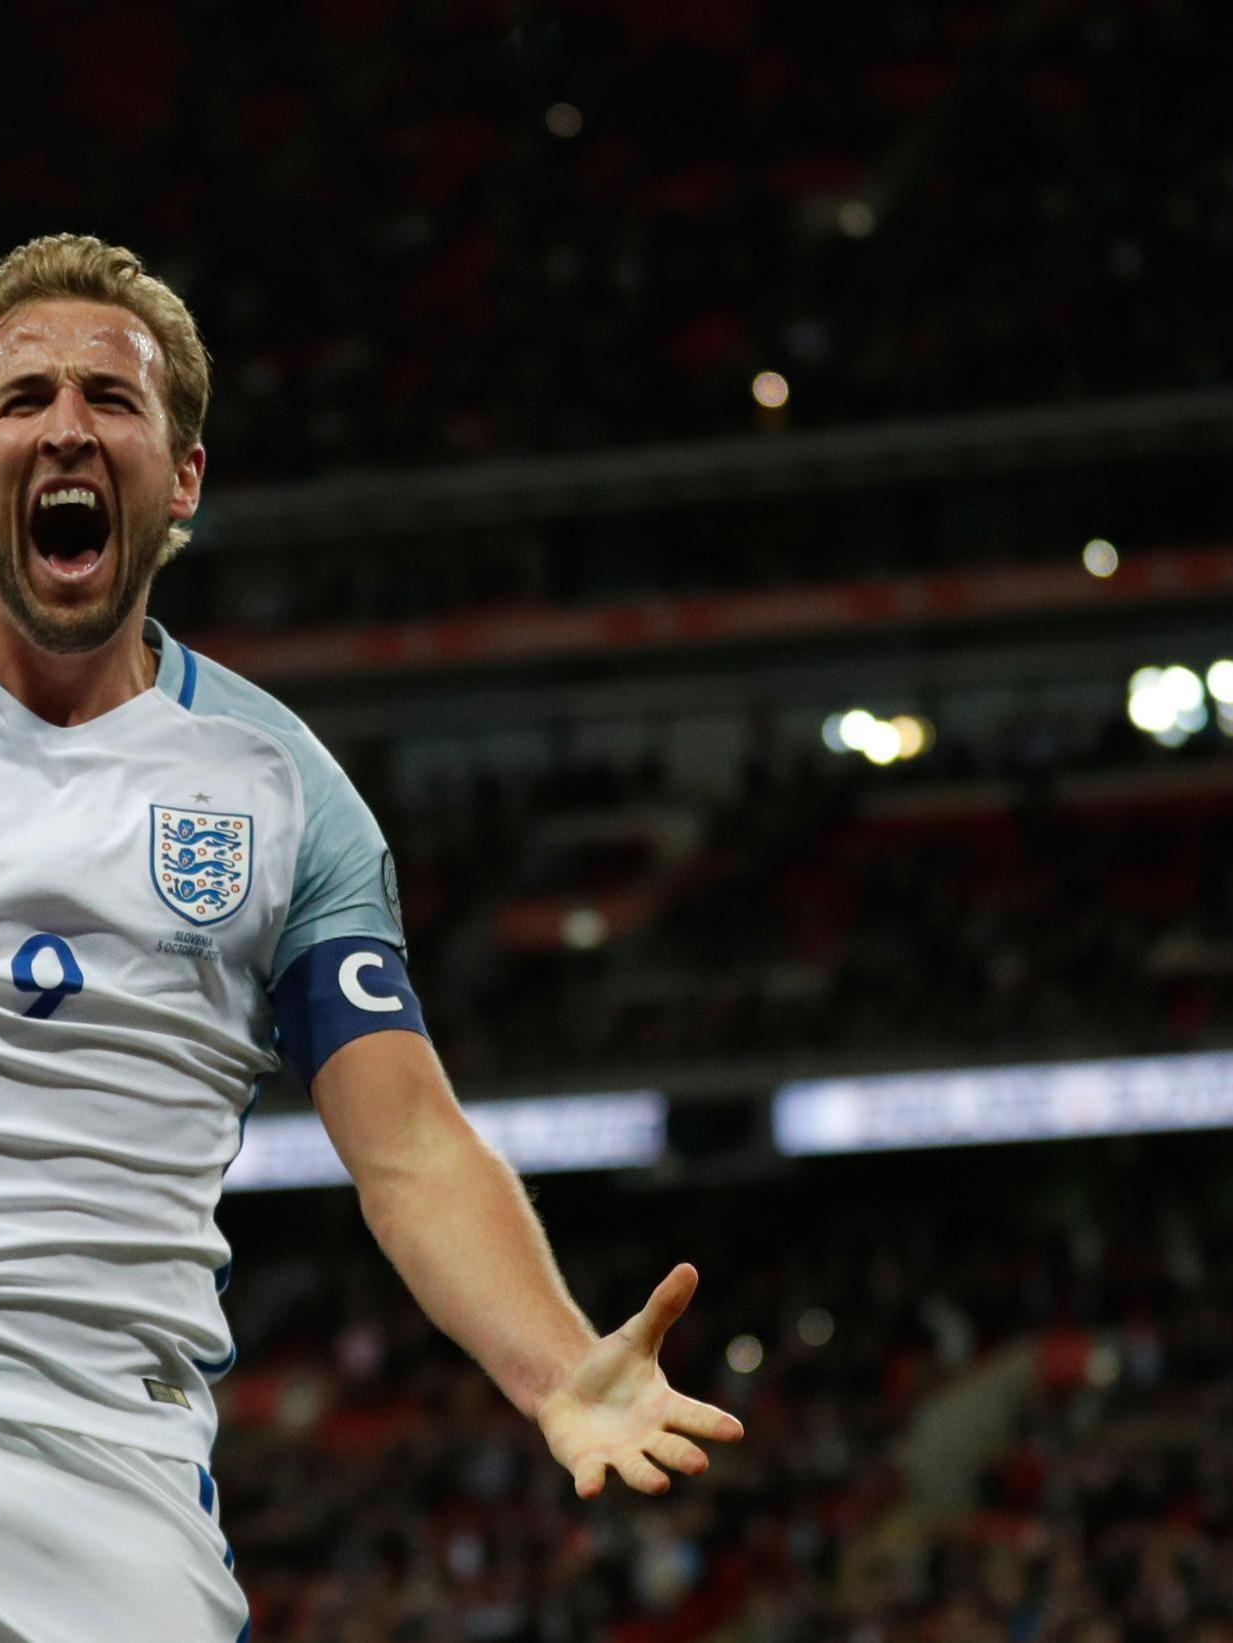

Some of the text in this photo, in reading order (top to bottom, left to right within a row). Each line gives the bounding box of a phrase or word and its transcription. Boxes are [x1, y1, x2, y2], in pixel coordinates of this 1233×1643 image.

[156, 940, 162, 952] 5
[164, 942, 204, 957] OCTOBER
[174, 930, 214, 947] SLOVENIA
[11, 932, 84, 1019] 9
[338, 951, 403, 1012] C
